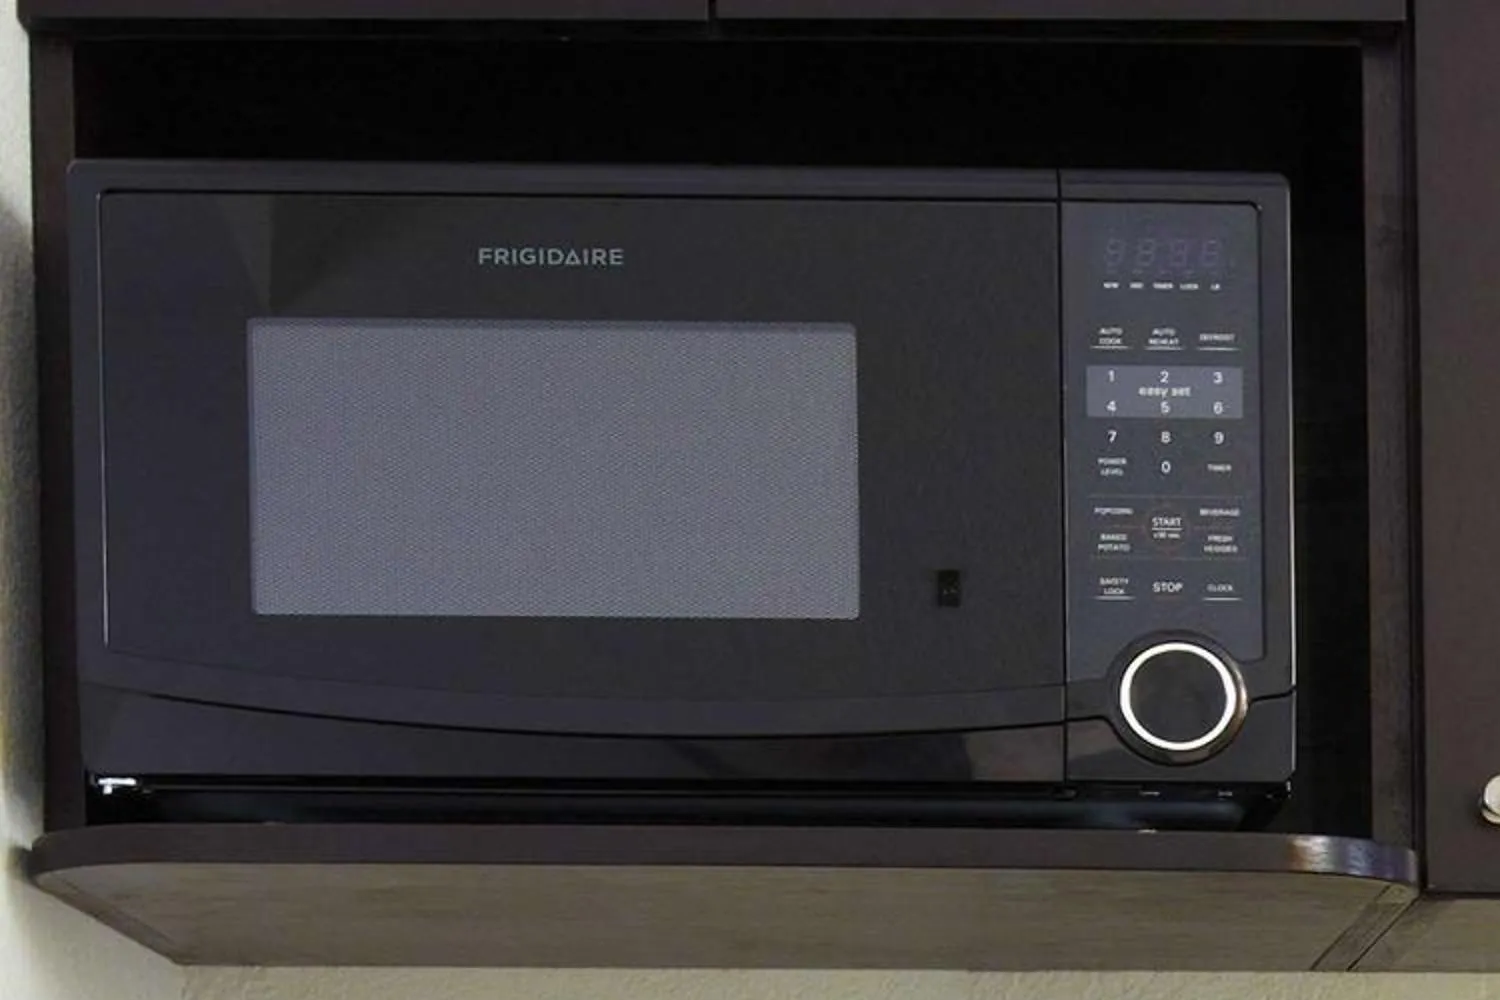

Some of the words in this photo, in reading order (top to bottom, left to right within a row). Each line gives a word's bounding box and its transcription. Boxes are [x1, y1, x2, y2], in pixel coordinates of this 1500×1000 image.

[477, 247, 625, 266] FRIGIDAIRE
[1099, 327, 1123, 335] AUTO
[1152, 327, 1176, 336] AUTO
[1108, 369, 1115, 382] 1
[1159, 370, 1169, 384] 2
[1212, 371, 1222, 385] 3
[1138, 386, 1168, 399] easy
[1170, 386, 1191, 397] set
[1106, 400, 1117, 413] 4
[1160, 401, 1170, 414] 5
[1213, 401, 1223, 415] 6
[1106, 430, 1117, 443] 7
[1160, 431, 1171, 444] 8
[1213, 431, 1224, 445] 9
[1160, 460, 1171, 474] 0
[1199, 508, 1240, 517] BEVERAGE
[1151, 516, 1182, 527] START
[1103, 587, 1125, 596] LOCK
[1152, 581, 1184, 594] STOP
[1206, 583, 1234, 593] CLOCK
